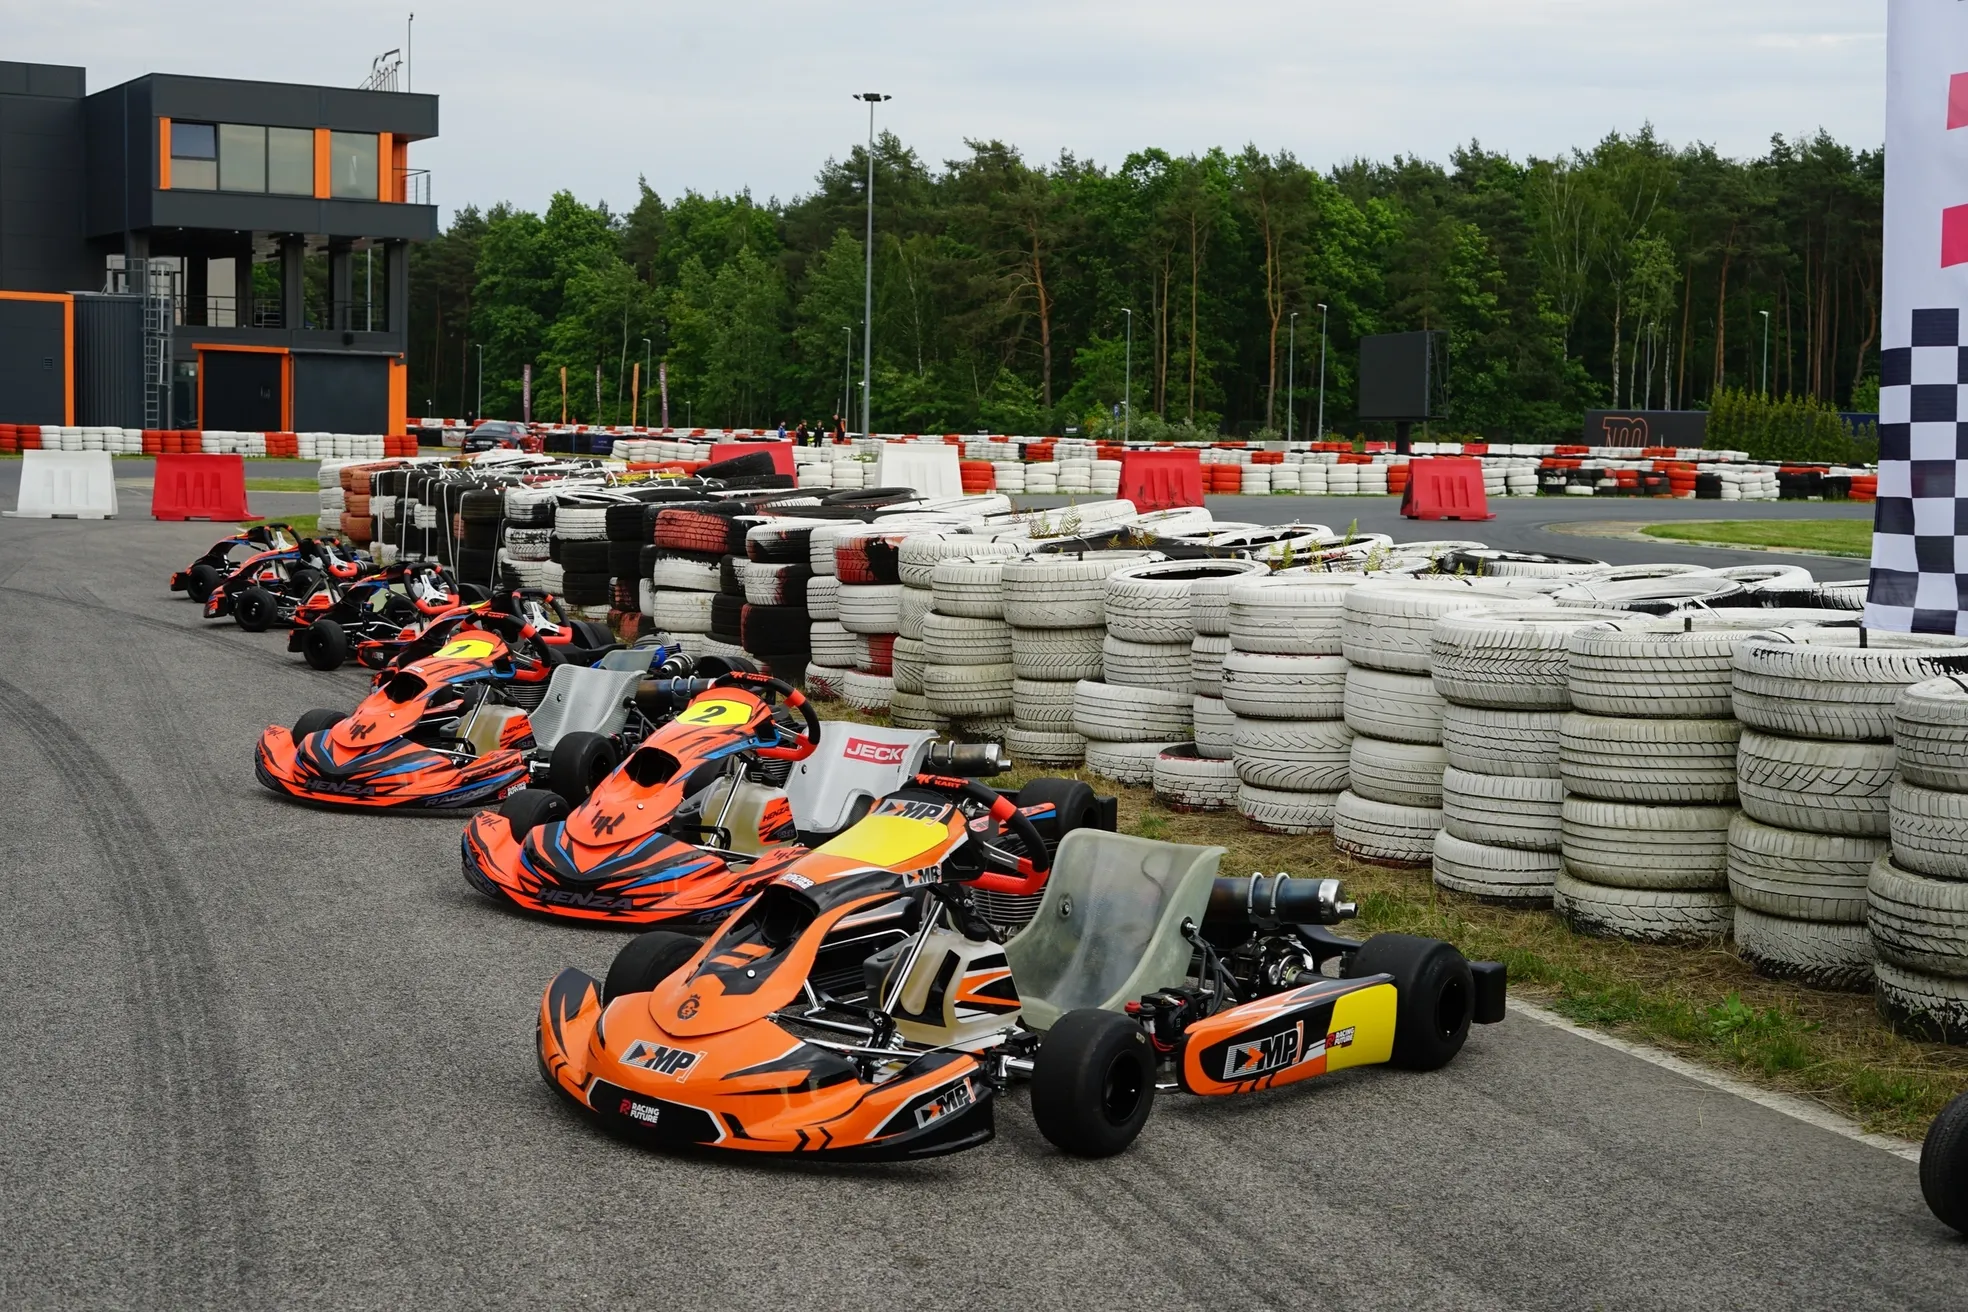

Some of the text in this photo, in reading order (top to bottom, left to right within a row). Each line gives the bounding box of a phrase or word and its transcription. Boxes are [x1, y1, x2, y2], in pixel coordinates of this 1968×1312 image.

[447, 644, 472, 656] 1
[688, 705, 727, 723] 2
[304, 779, 376, 796] HENZA
[536, 887, 634, 910] HENZA
[1335, 1027, 1355, 1038] RACING
[630, 1109, 659, 1124] FUTURE
[631, 1103, 660, 1116] RACING
